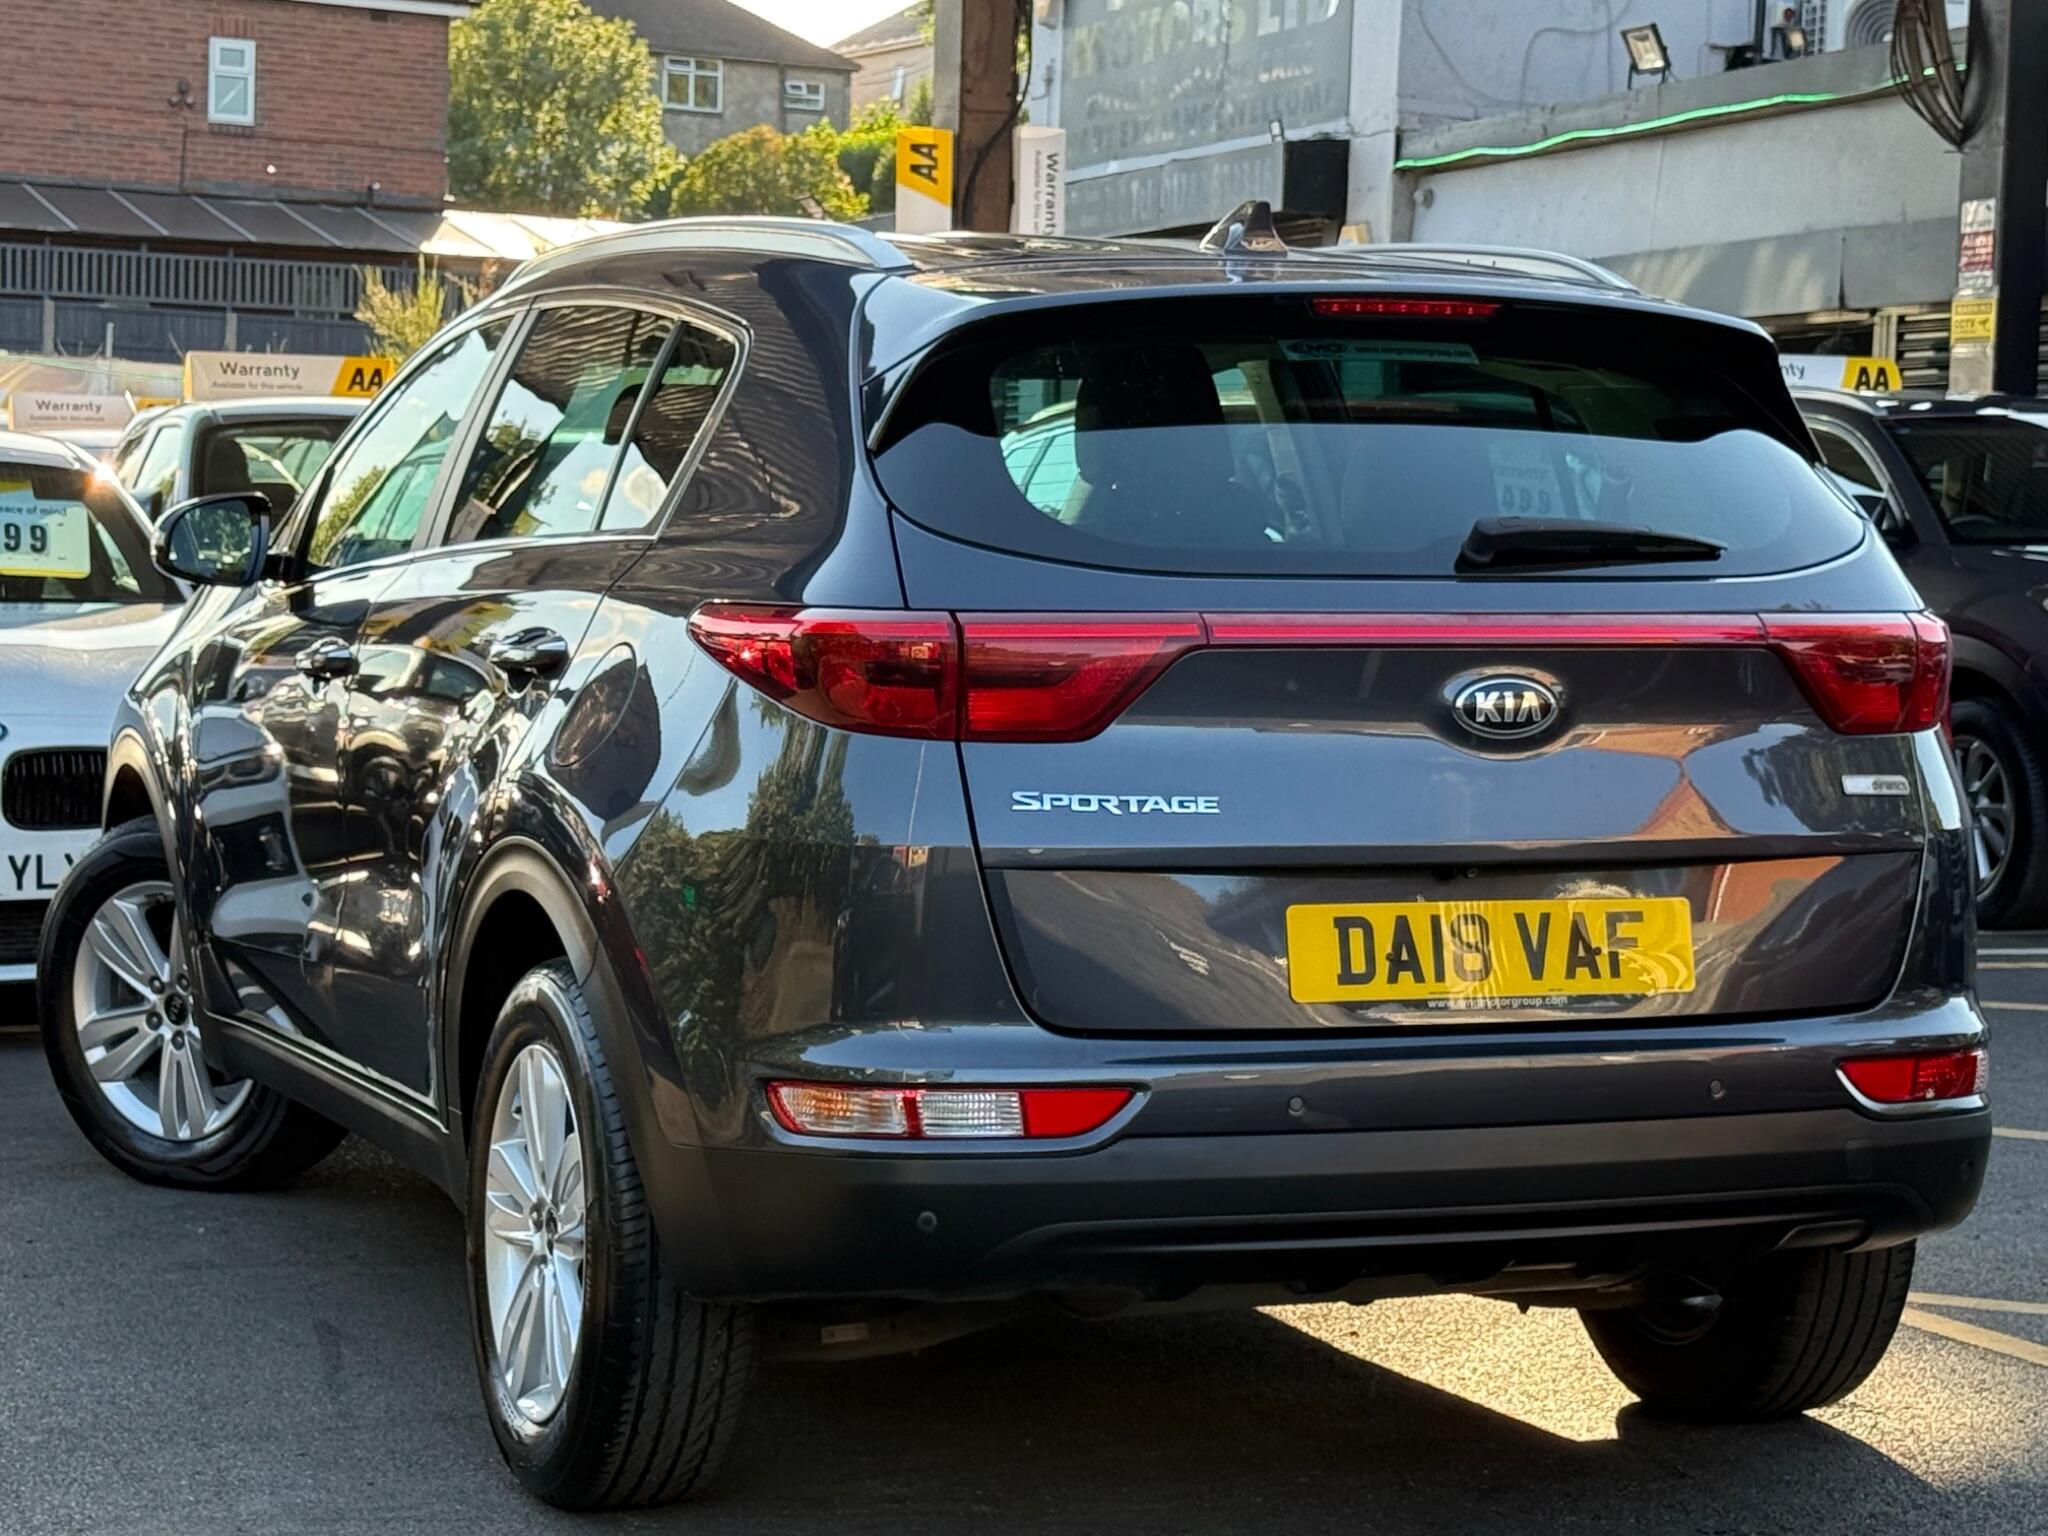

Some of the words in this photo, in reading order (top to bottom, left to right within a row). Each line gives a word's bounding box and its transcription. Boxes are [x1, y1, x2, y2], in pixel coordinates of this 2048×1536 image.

[909, 143, 938, 185] AA
[1043, 152, 1059, 235] Warranty
[219, 361, 300, 380] Warranty
[347, 367, 383, 392] AA
[1855, 366, 1889, 391] AA
[36, 399, 102, 414] Warranty
[4, 523, 47, 553] 99
[1474, 691, 1541, 722] KIA
[1012, 791, 1220, 815] SPORTAGE
[1334, 912, 1493, 985] DA18
[1513, 909, 1644, 981] VAF
